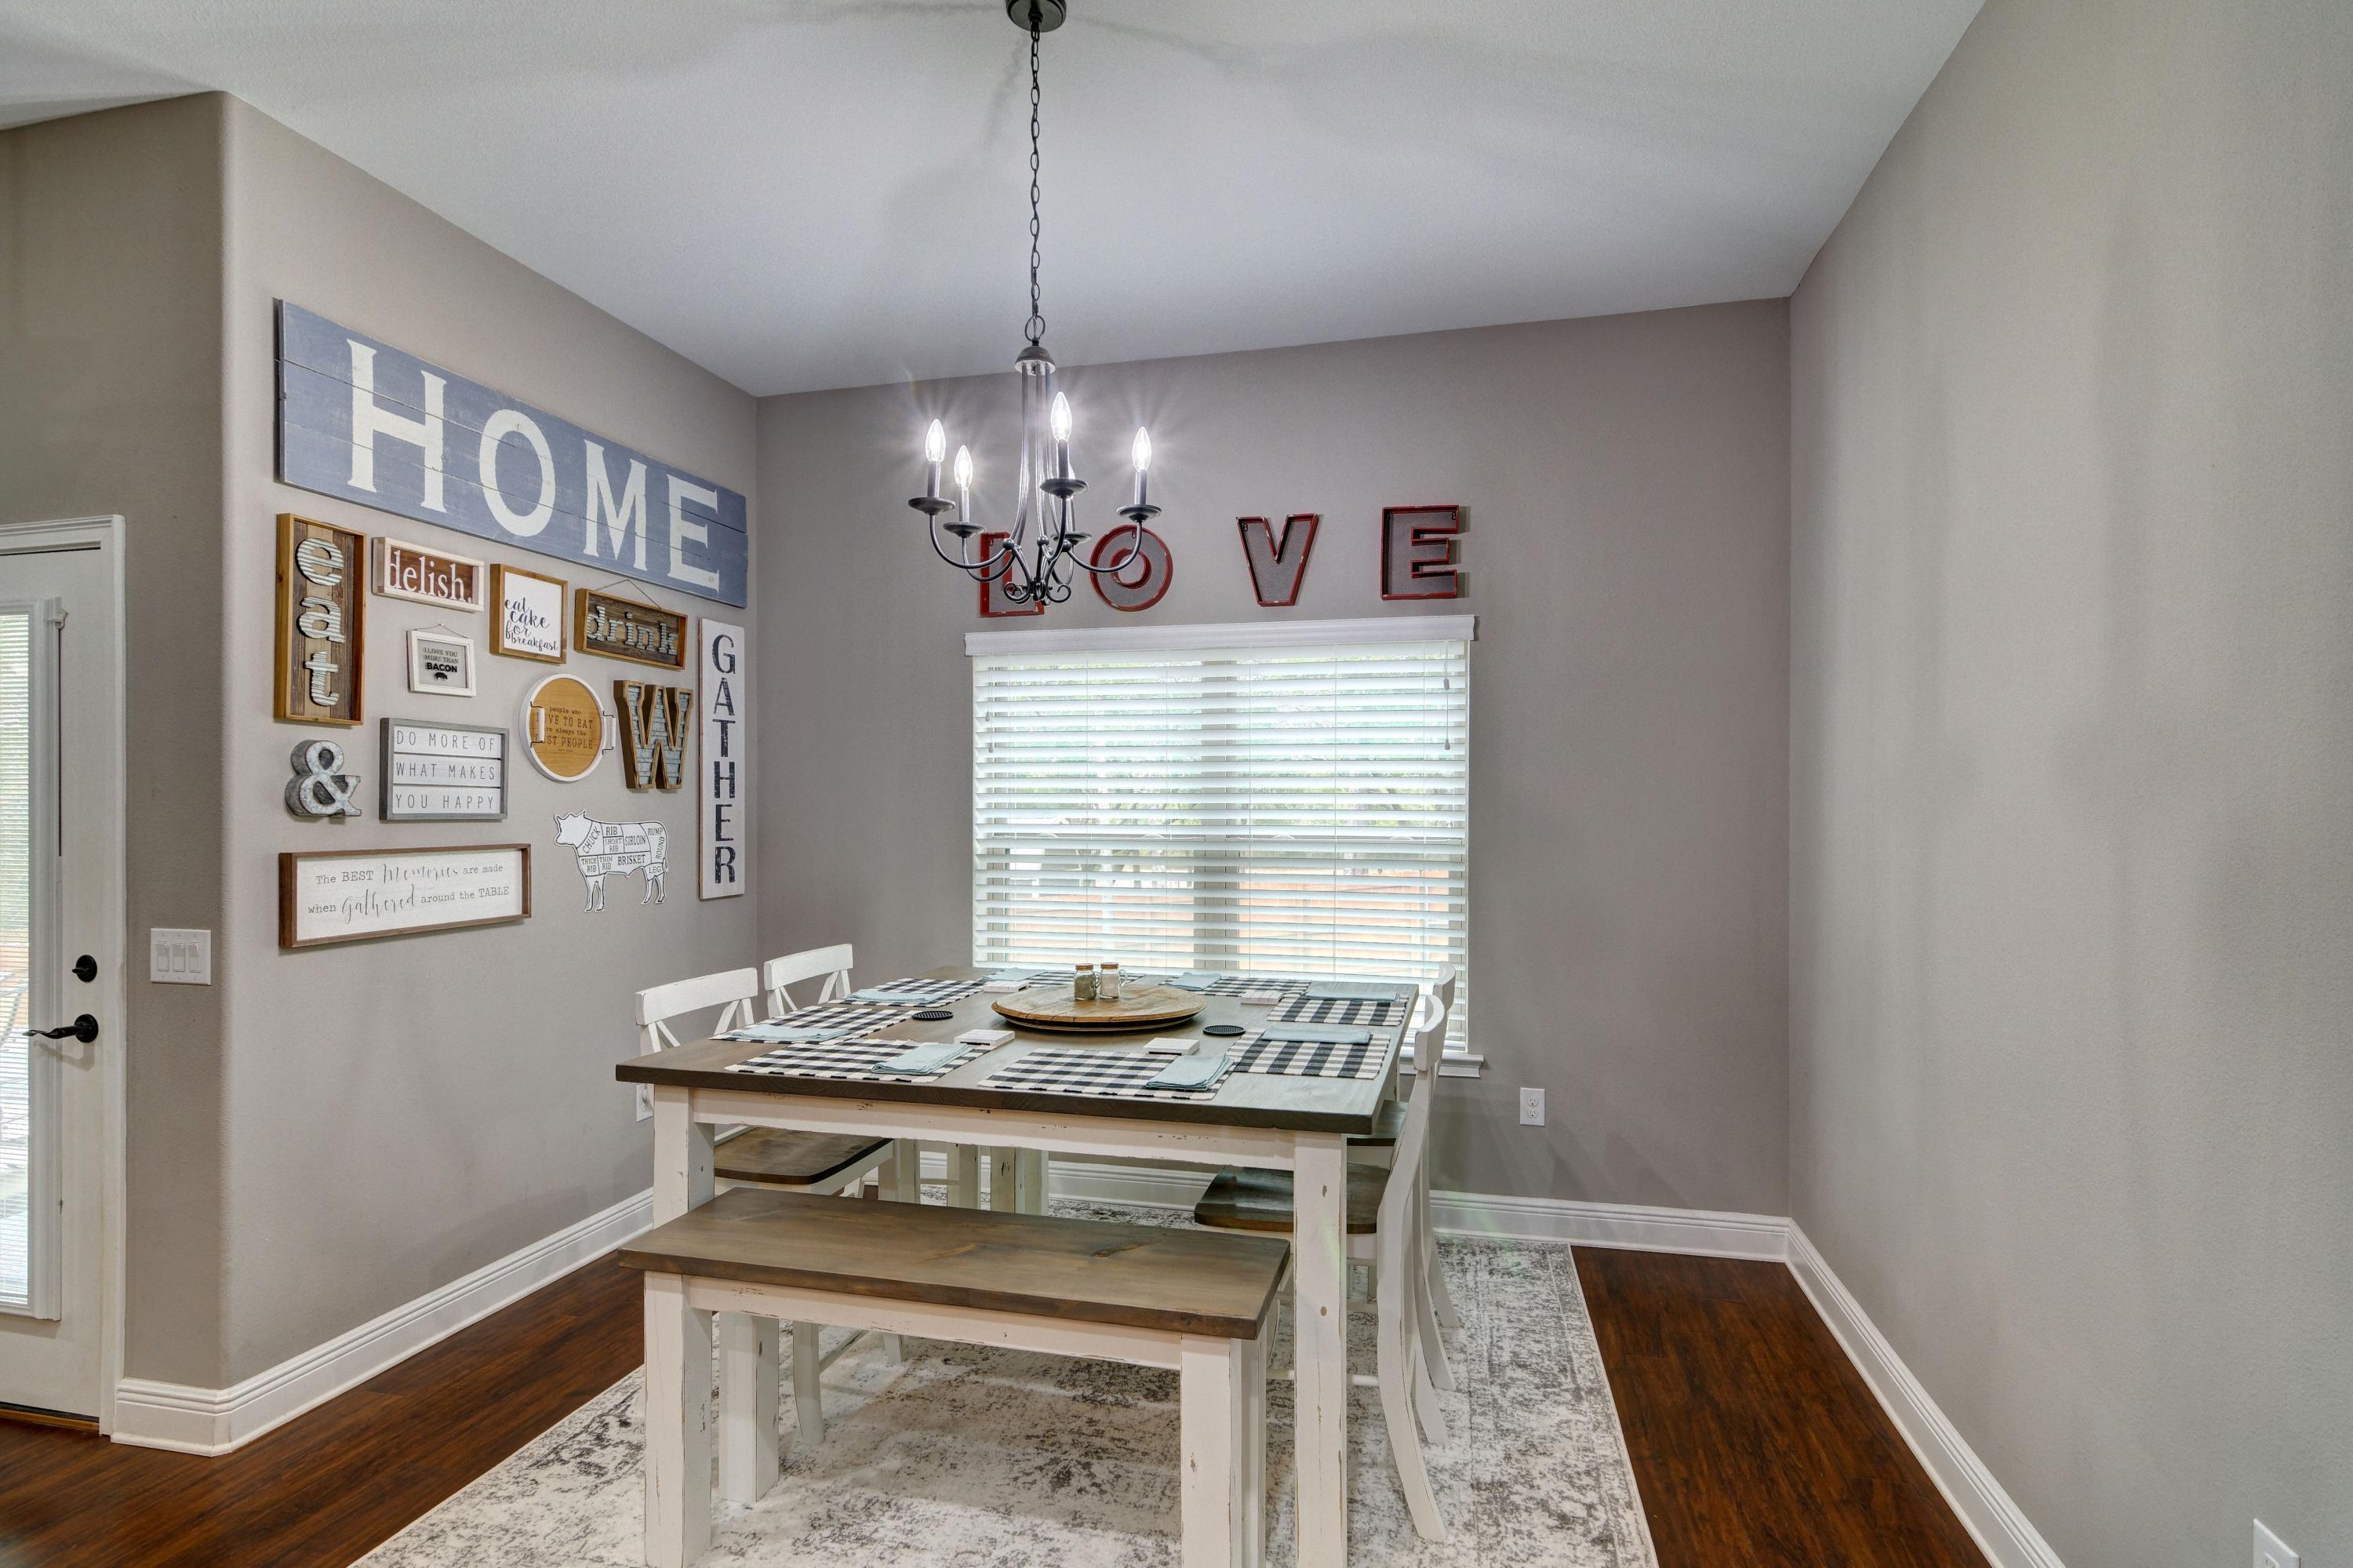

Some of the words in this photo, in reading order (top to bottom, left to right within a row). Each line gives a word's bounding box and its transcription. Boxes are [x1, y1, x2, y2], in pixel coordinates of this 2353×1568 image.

[347, 338, 719, 595] HOME
[390, 550, 472, 603] delish.
[504, 597, 529, 613] eat
[296, 537, 345, 706] eat
[510, 609, 551, 628] cake
[505, 620, 531, 639] for
[587, 606, 678, 655] drink
[511, 632, 558, 652] breakfast
[426, 662, 457, 672] BACON
[563, 716, 573, 726] TO
[577, 718, 593, 729] EAT
[397, 730, 416, 745] DO
[429, 733, 468, 749] MORE
[478, 737, 495, 751] OF
[562, 737, 593, 749] PEOPLE
[614, 680, 693, 789] W
[712, 634, 736, 883] GATHER
[285, 740, 362, 817] &
[396, 762, 437, 777] WHAT
[448, 765, 495, 780] MAKES
[396, 794, 427, 809] YOU
[443, 795, 493, 809] HAPPY
[582, 826, 601, 854] CHUCK
[606, 826, 617, 835] RIB
[647, 828, 663, 836] RUMP
[624, 835, 646, 846] SIRLOIN
[655, 836, 665, 860] ROUND
[617, 854, 646, 865] BRISKET
[315, 875, 336, 885] The
[341, 870, 374, 882] BEST
[482, 864, 503, 873] made
[649, 865, 661, 874] LEG
[307, 904, 336, 914] when
[420, 893, 455, 904] around
[459, 891, 475, 900] the
[478, 886, 509, 897] TABLE
